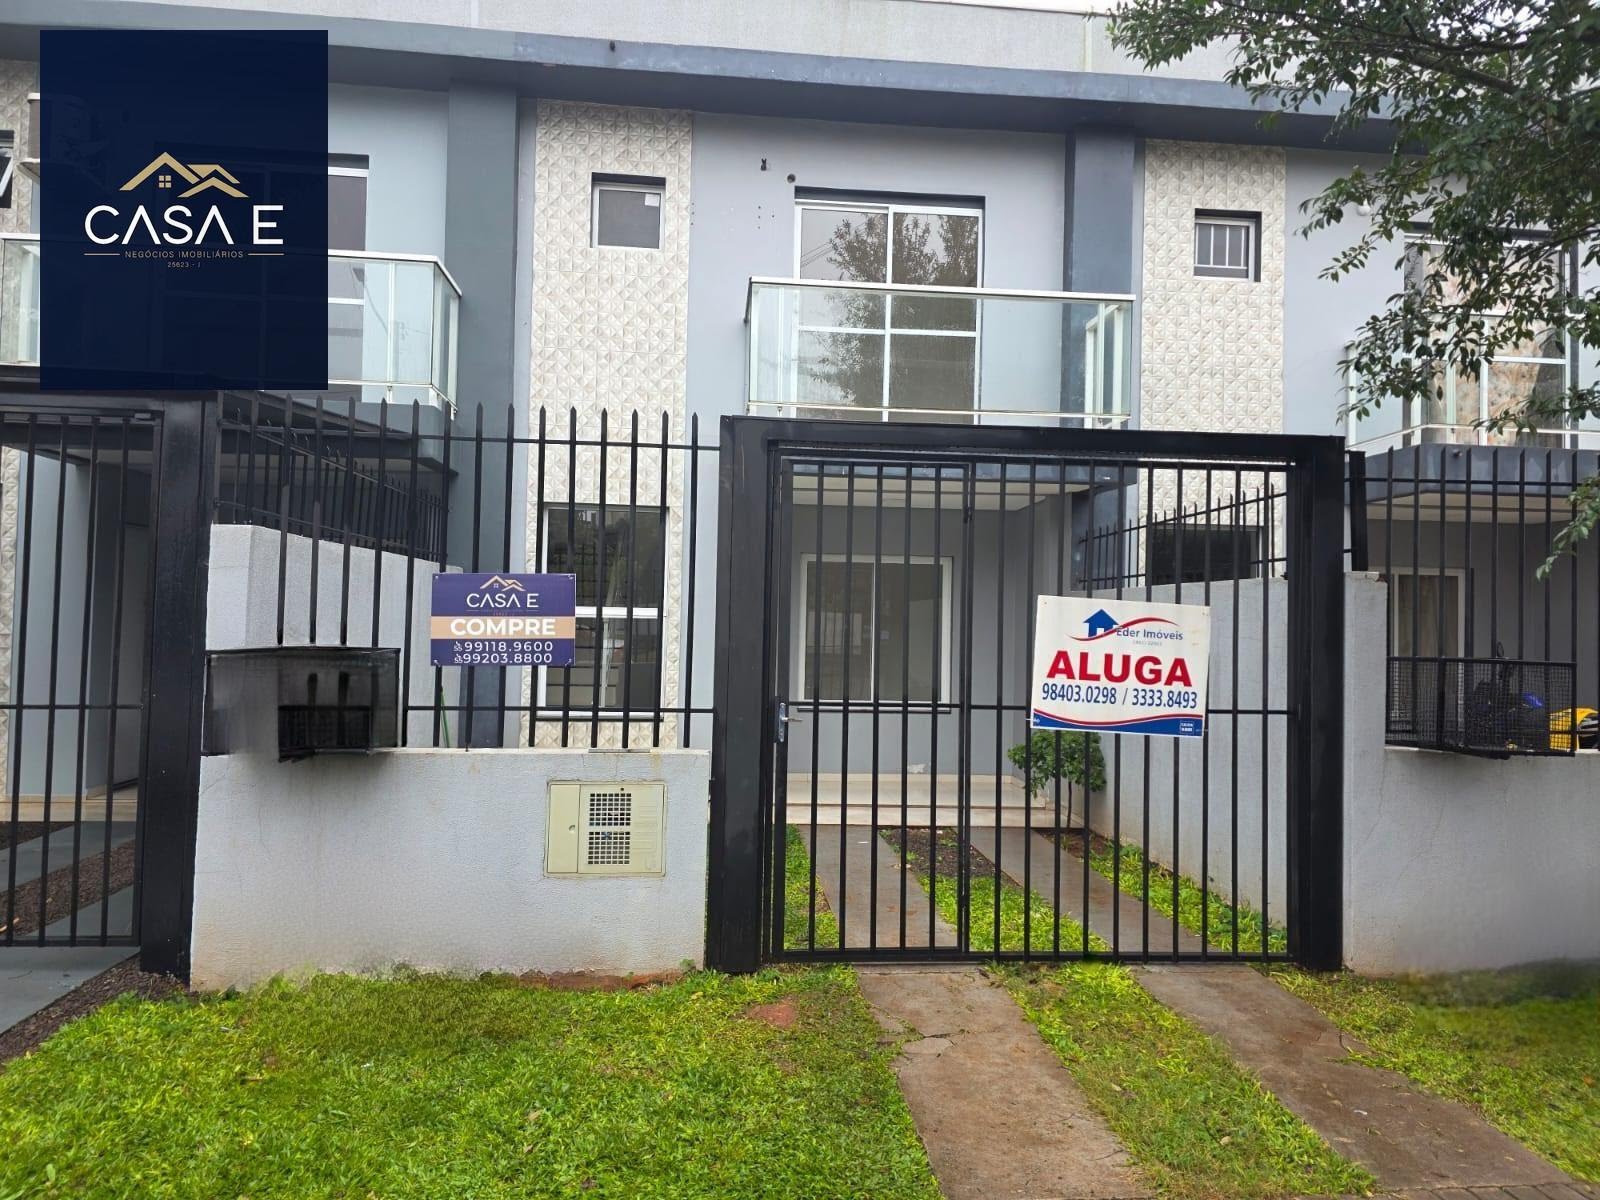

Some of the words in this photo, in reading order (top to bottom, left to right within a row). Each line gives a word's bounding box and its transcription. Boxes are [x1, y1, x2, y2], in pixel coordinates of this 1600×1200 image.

[466, 593, 521, 608] CASA
[526, 593, 540, 608] E
[450, 618, 556, 636] COMPRE
[1116, 627, 1141, 638] Eder
[1143, 628, 1184, 641] Imóveis
[464, 641, 553, 652] 99118.9600
[463, 653, 553, 664] 99203.8800
[1046, 650, 1193, 687] ALUGA
[1042, 682, 1117, 705] 98403.0298
[1122, 687, 1129, 706] /
[1132, 688, 1198, 709] 3333.8493
